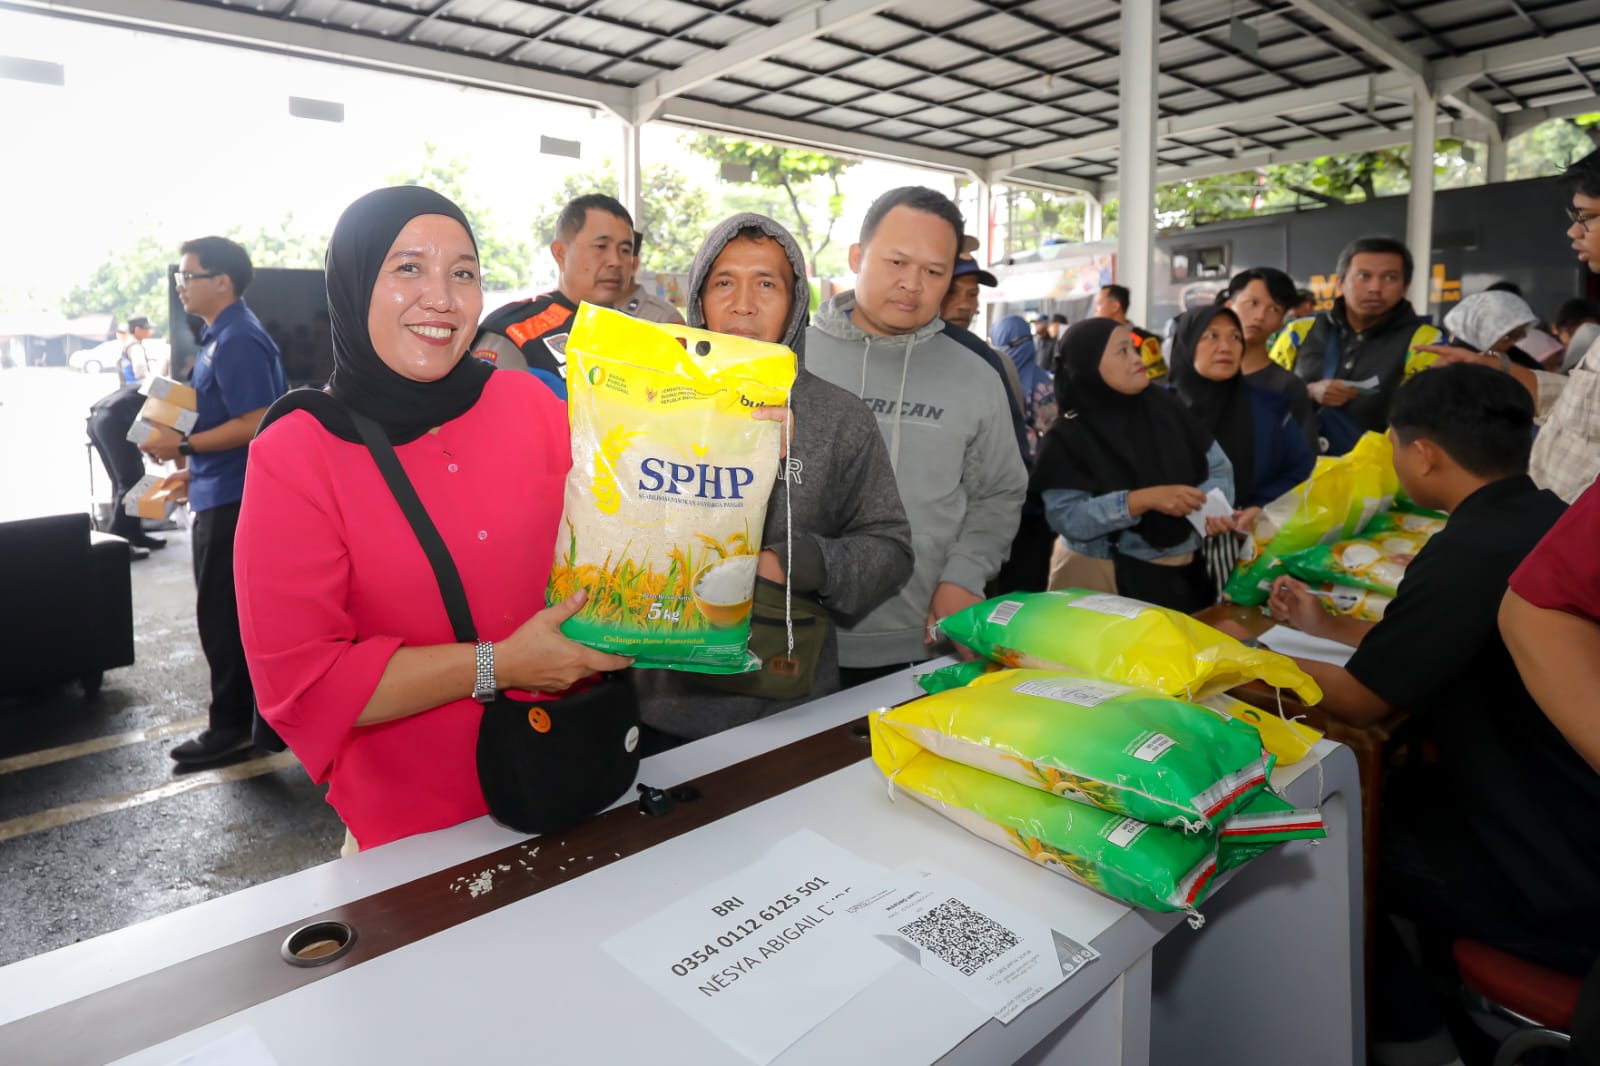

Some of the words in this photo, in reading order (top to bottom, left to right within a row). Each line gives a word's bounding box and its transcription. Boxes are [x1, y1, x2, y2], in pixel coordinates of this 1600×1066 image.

[638, 457, 754, 500] SPHP
[648, 602, 663, 620] 5
[663, 608, 680, 623] kg
[671, 944, 720, 977] 0354
[716, 918, 763, 948] 0112
[759, 893, 801, 921] 6125
[796, 876, 830, 897] 501
[711, 896, 745, 917] BRI
[698, 955, 762, 997] NESYA
[758, 914, 824, 959] ABIGAIL
